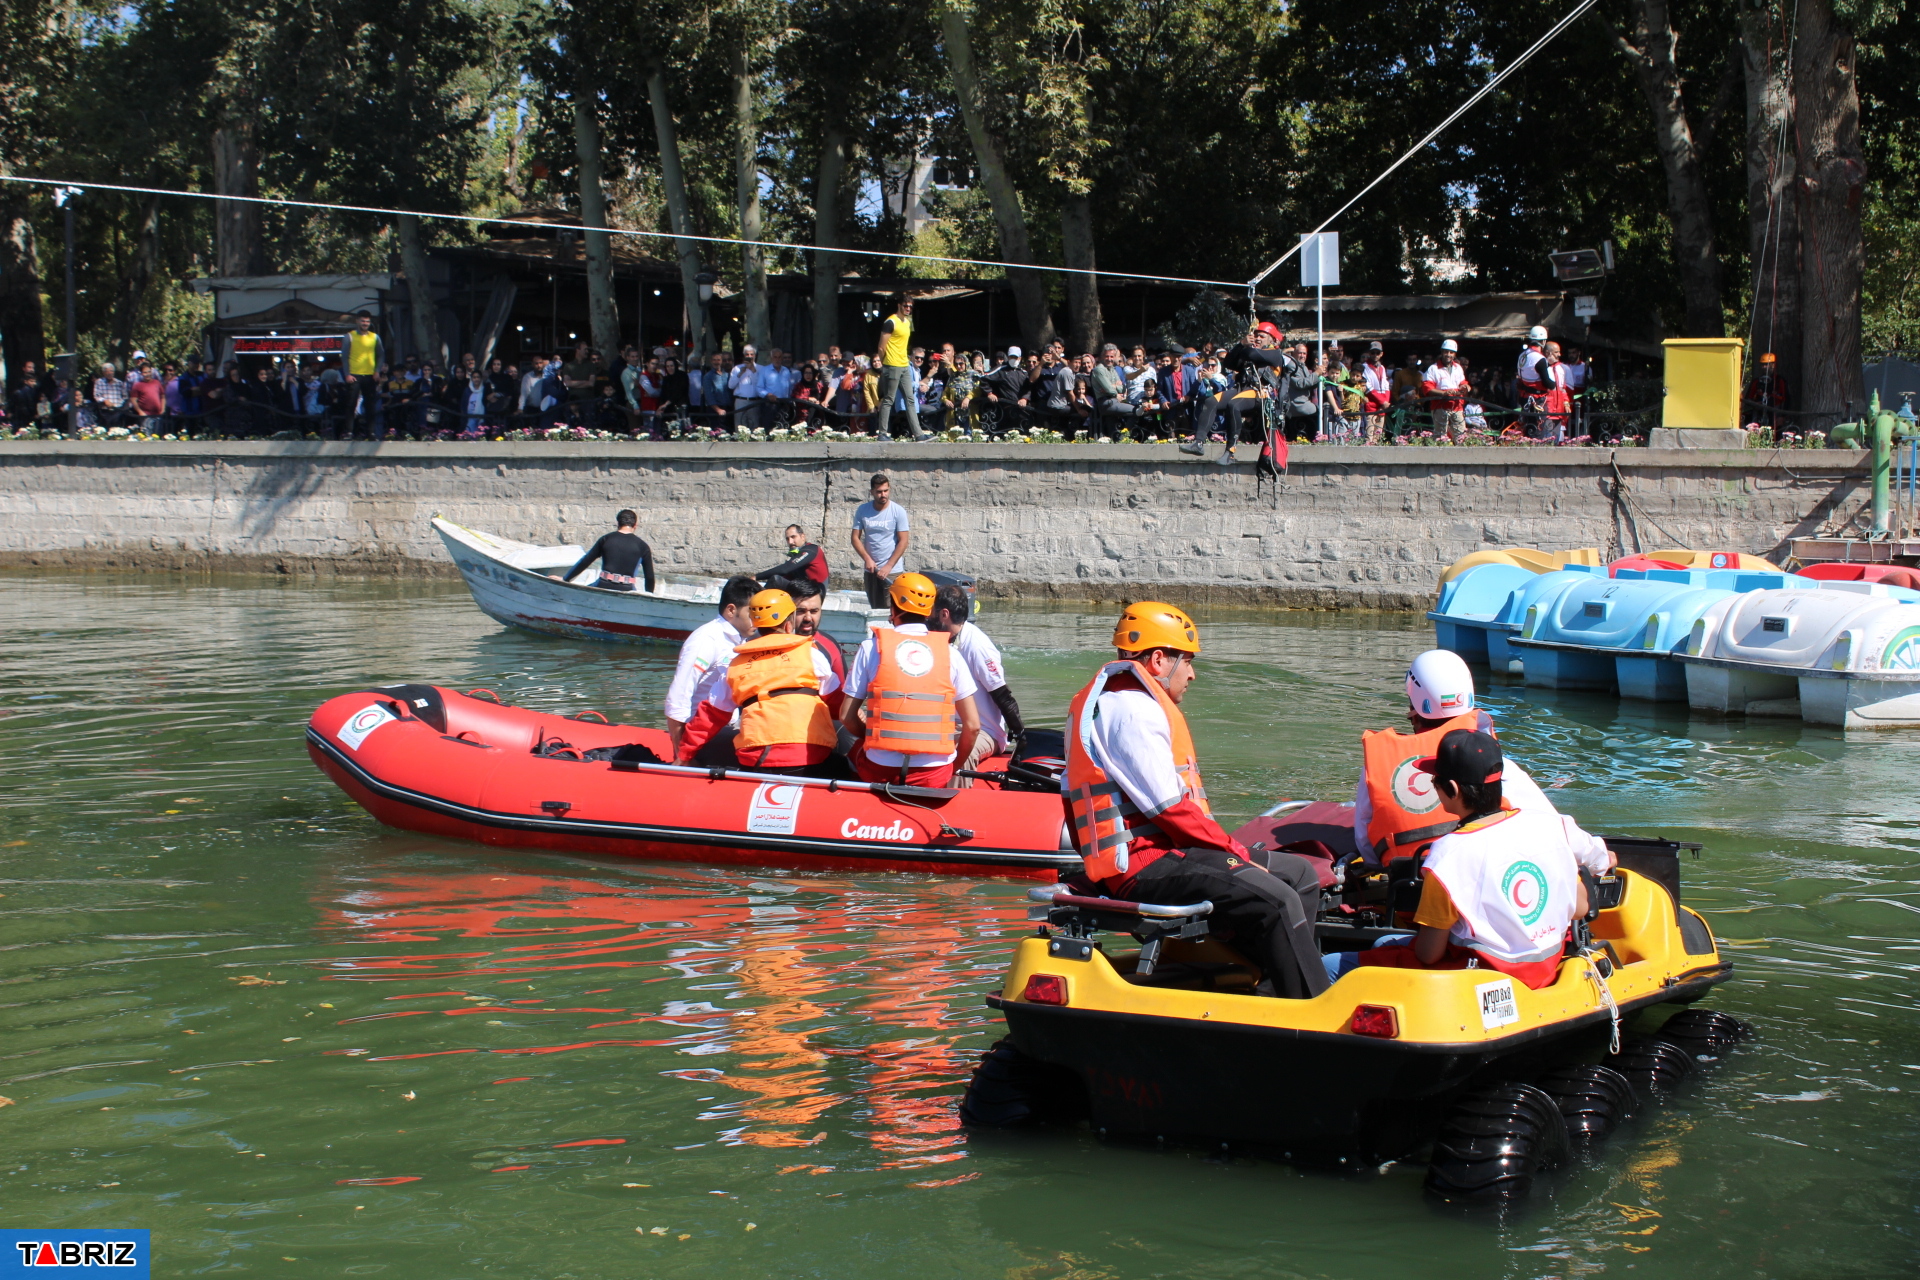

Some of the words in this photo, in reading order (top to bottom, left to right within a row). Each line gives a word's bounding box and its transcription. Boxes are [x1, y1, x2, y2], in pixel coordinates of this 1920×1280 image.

[840, 817, 914, 842] Cando
[1483, 989, 1500, 1015] Argo
[1500, 986, 1512, 1002] 8x8
